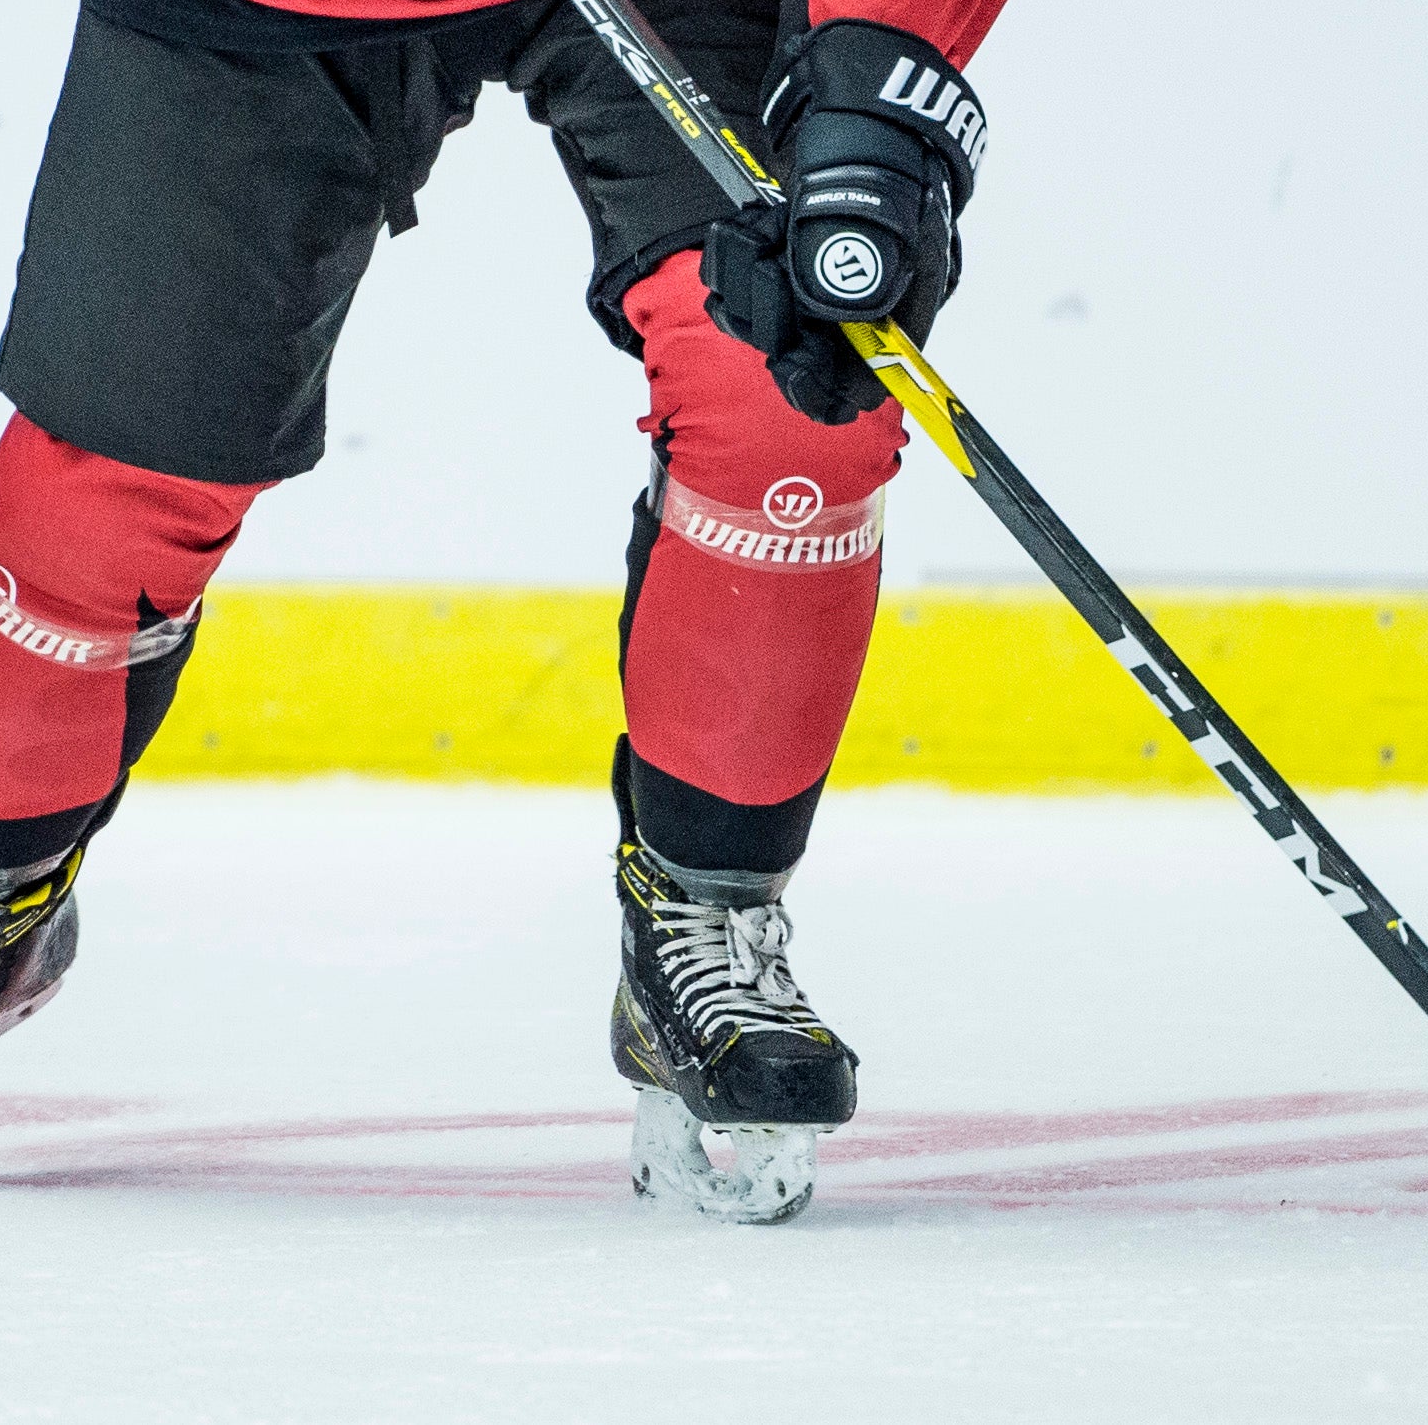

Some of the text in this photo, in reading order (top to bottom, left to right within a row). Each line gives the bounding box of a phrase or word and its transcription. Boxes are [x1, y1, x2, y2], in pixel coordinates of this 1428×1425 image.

[653, 83, 701, 138] PRO
[685, 513, 873, 564] WARRIOR
[1106, 623, 1369, 918] CCM
